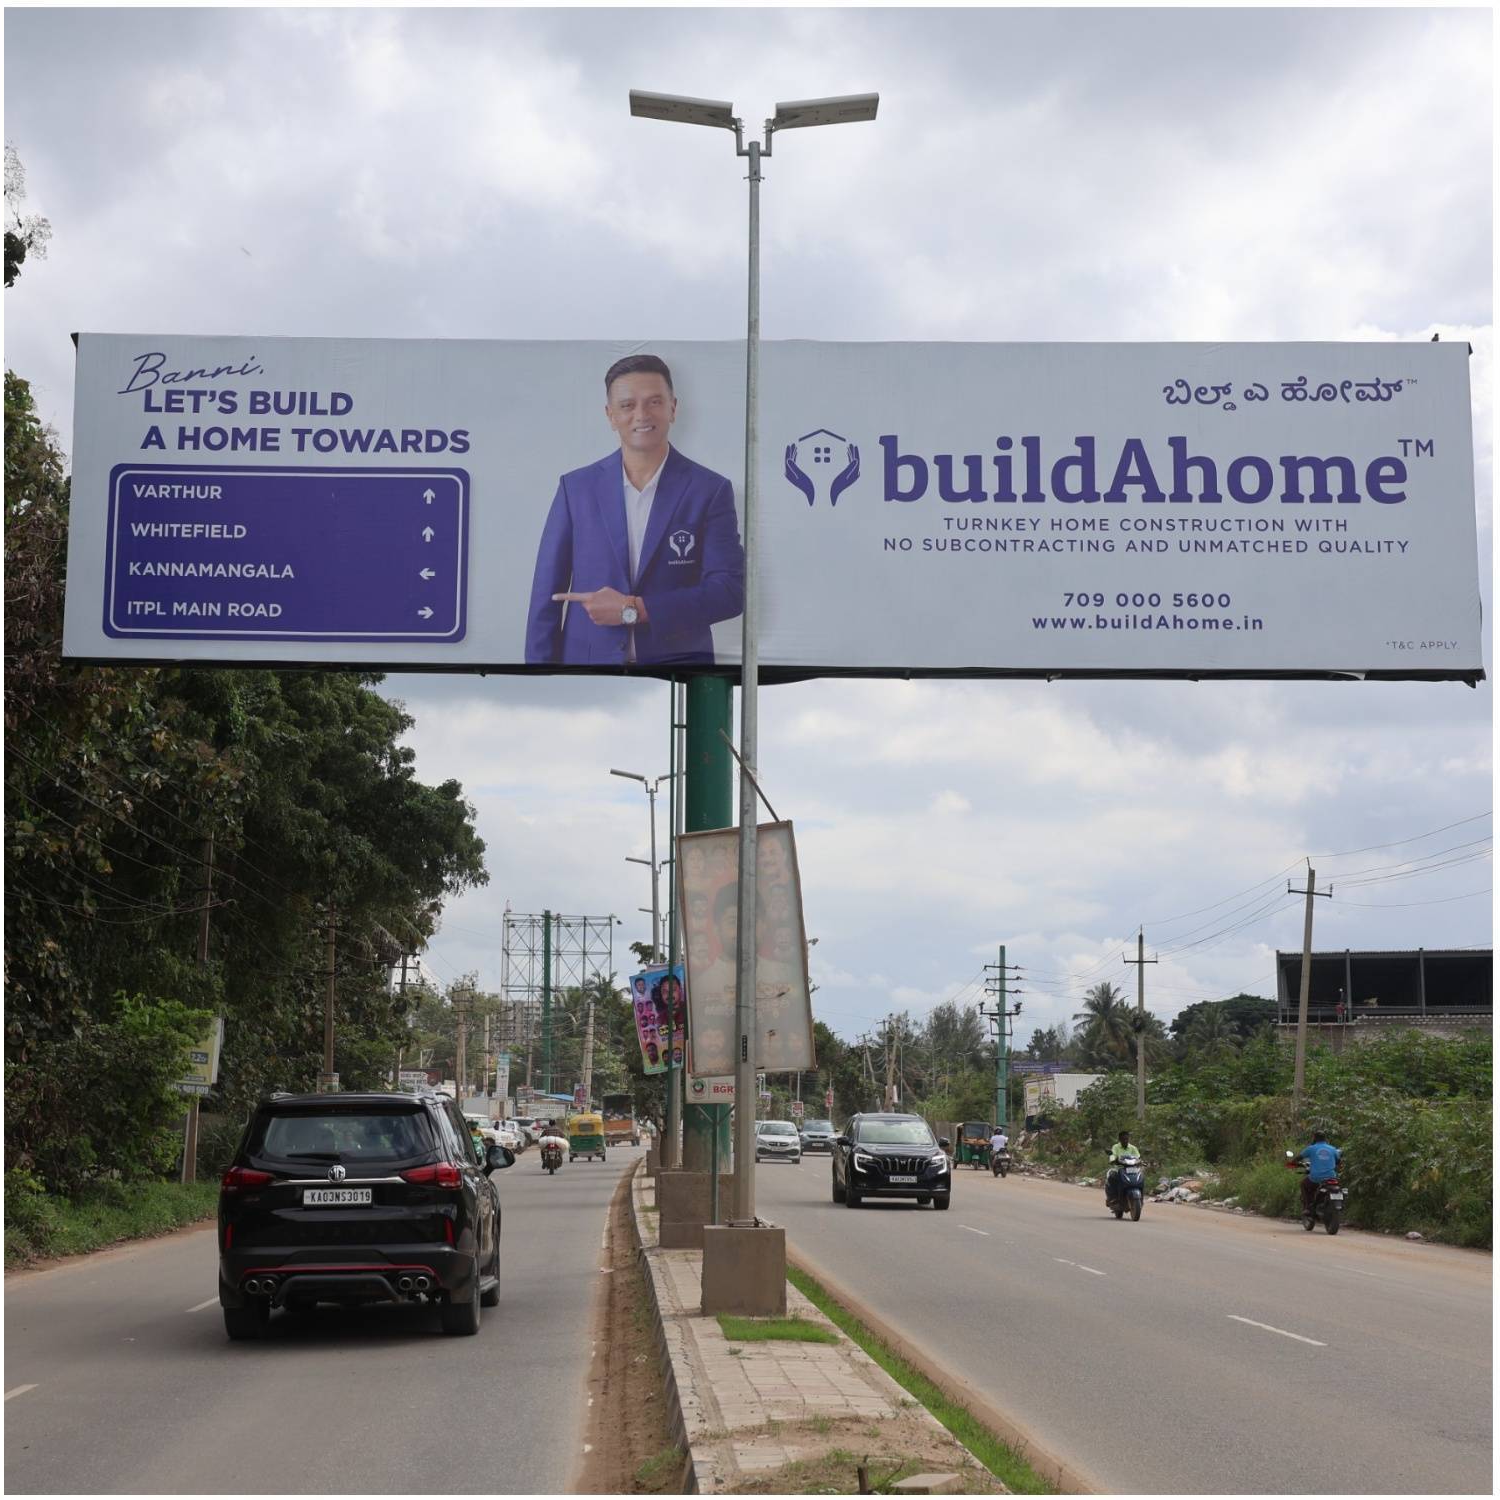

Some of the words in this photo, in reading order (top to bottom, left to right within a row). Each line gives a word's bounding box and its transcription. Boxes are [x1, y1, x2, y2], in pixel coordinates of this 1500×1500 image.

[1243, 381, 1269, 401] ಎ
[144, 388, 238, 415] LET’S
[249, 390, 353, 417] BUILD
[140, 426, 166, 450] A
[177, 426, 280, 452] HOME
[291, 427, 470, 455] TOWARDS
[133, 484, 222, 500] VARTHUR
[130, 523, 247, 540] WHITEFIELD
[943, 518, 1041, 532] TURNKEY
[1050, 518, 1110, 532] HOME
[1120, 518, 1285, 532] CONSTRUCTION
[1294, 519, 1348, 532] WITH
[884, 539, 913, 552] NO
[922, 539, 1115, 553] SUBCONTRACTING
[1125, 539, 1169, 553] AND
[1179, 540, 1308, 554] UNMATCHED
[1318, 540, 1410, 554] QUALITY
[129, 562, 294, 579] KANNAMANGALA
[1063, 593, 1105, 608] 709
[1115, 593, 1161, 608] 000
[1173, 593, 1231, 608] 5600
[127, 601, 167, 617] ITPL
[172, 601, 222, 617] MAIN
[227, 602, 282, 618] ROAD
[1032, 614, 1263, 631] www.buildAhome.in
